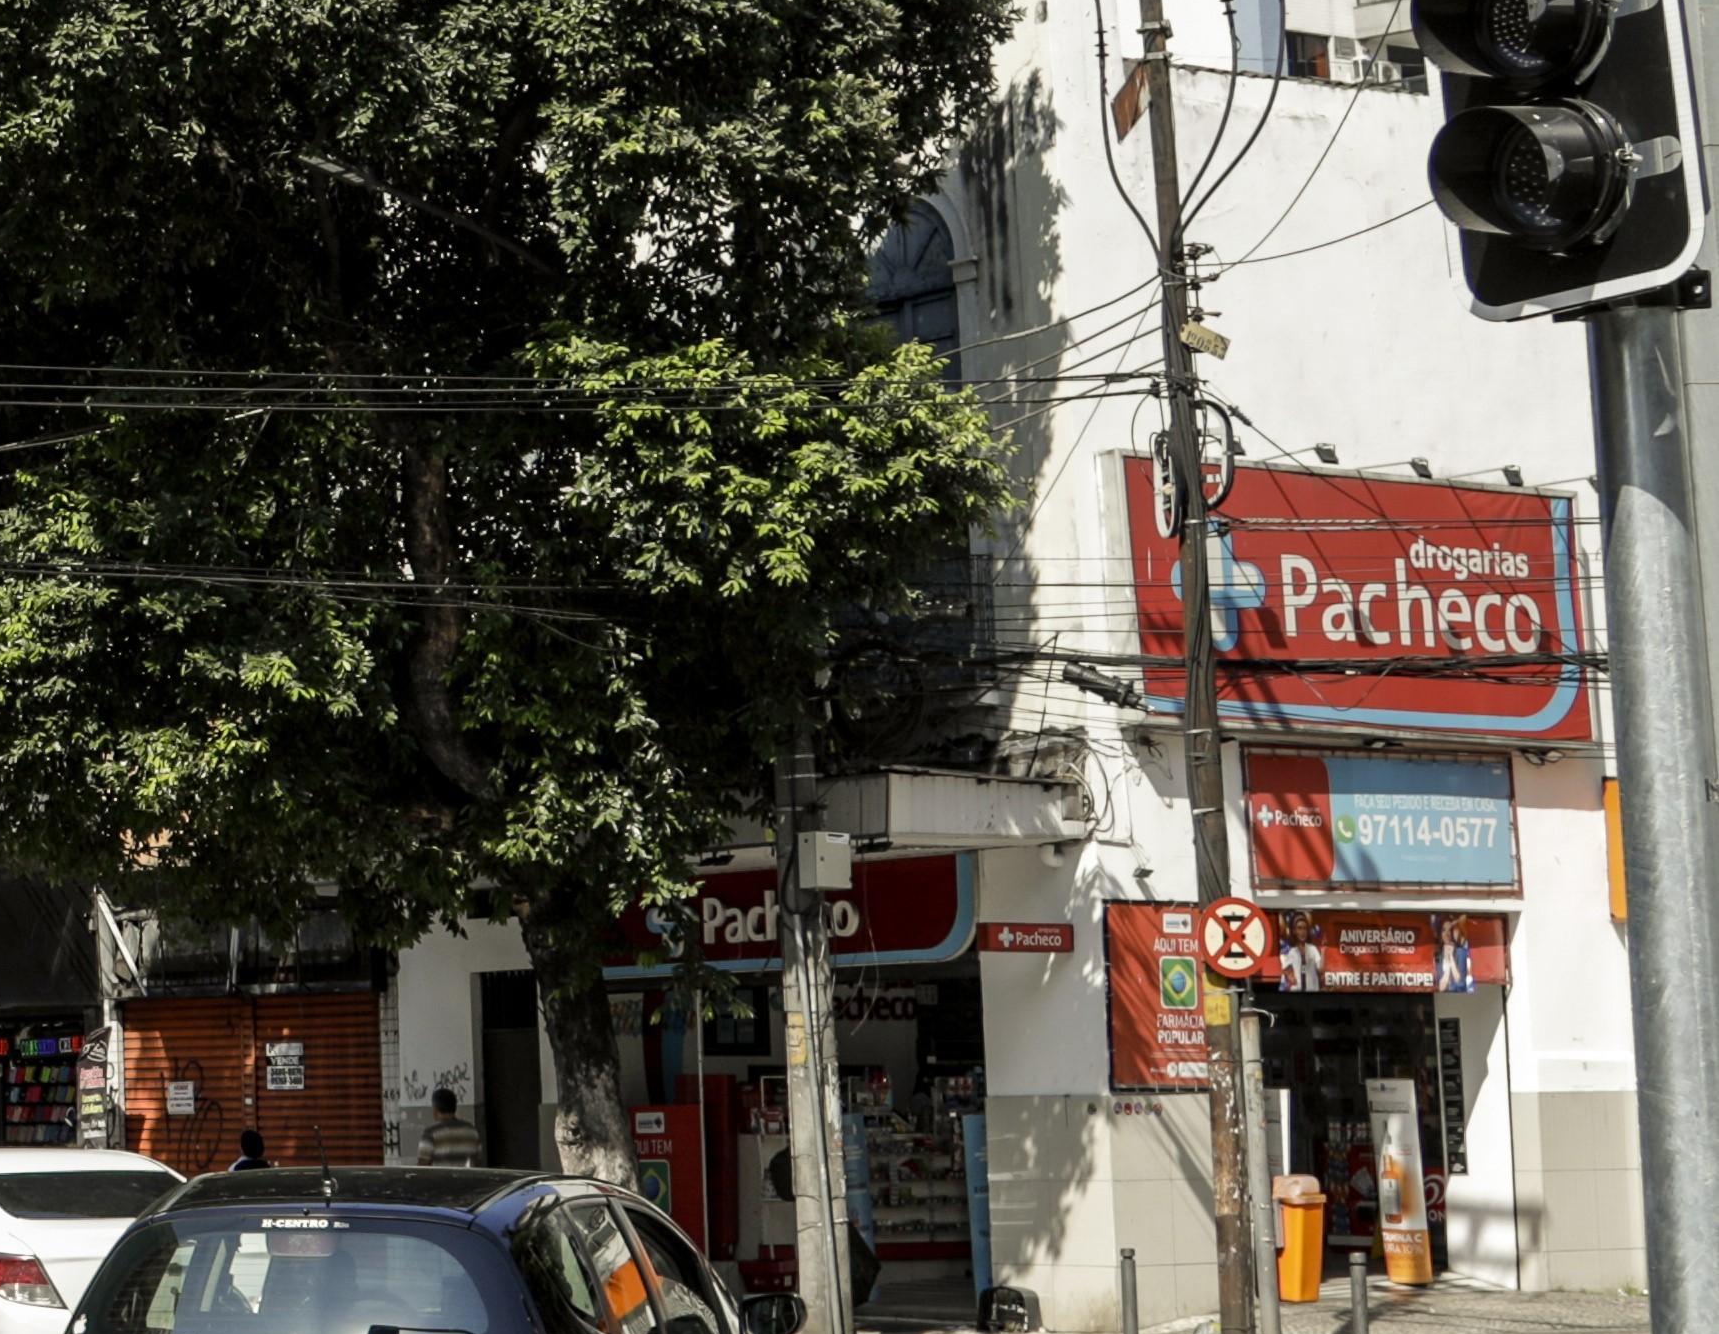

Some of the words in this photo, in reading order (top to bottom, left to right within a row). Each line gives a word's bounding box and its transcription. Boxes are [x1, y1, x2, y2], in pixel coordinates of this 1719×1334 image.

[1410, 535, 1530, 580] drogarias
[1280, 553, 1542, 653] Pacheco
[1392, 795, 1422, 810] PEDIDO
[1431, 796, 1461, 811] RECEBA
[1275, 809, 1322, 827] Pacheco
[1358, 814, 1497, 847] 97114-0577
[702, 890, 859, 945] Pacho
[1016, 931, 1062, 946] Pacheco
[1340, 927, 1415, 944] ANIVERSÁRIO
[1154, 938, 1177, 953] AQUI
[1179, 939, 1199, 953] TEM
[1325, 972, 1361, 986] ENTRE
[1363, 972, 1369, 985] E
[1372, 972, 1434, 987] PARTICIPE!
[833, 988, 919, 1021] acheco
[1157, 1013, 1205, 1028] FARMÁCIA
[1158, 1031, 1205, 1045] POPULAR
[262, 1218, 329, 1229] H-CENTRO
